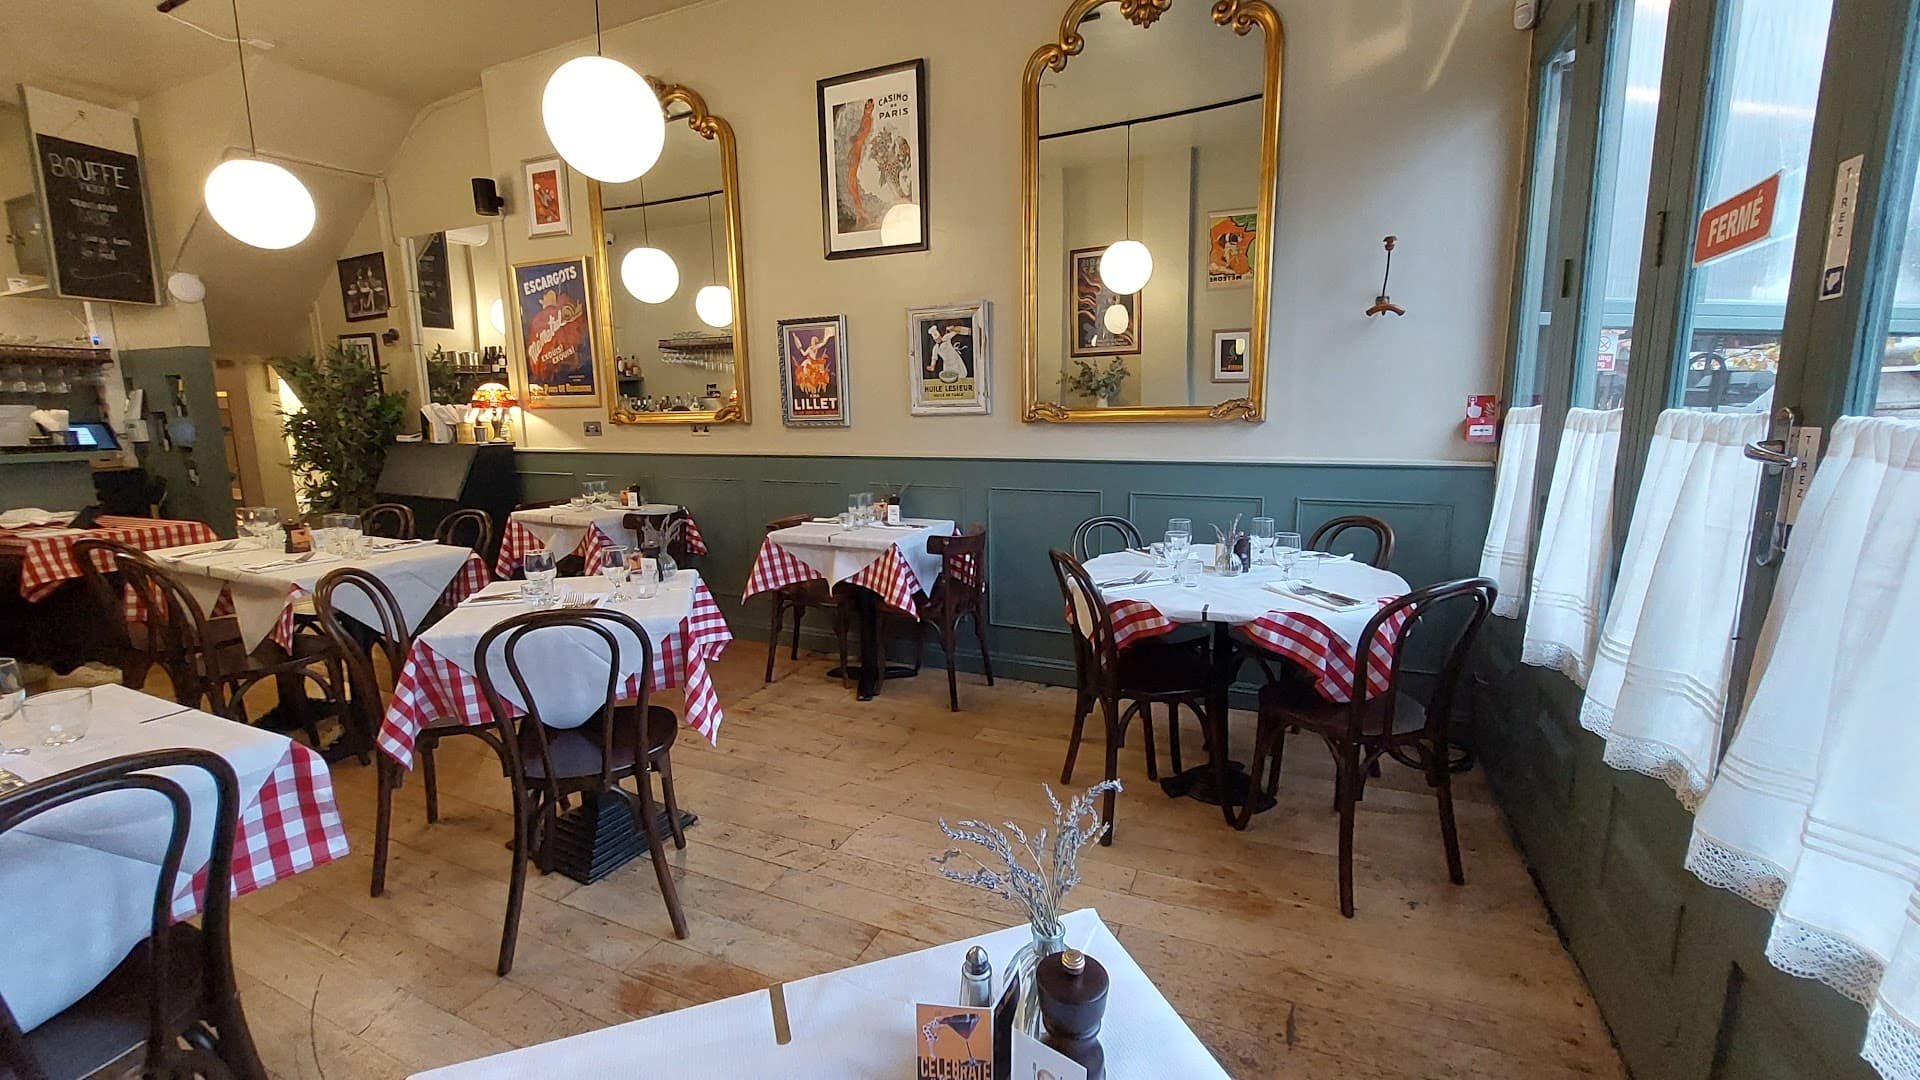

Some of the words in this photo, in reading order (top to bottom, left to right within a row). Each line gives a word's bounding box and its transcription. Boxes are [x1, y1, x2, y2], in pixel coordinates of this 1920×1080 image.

[879, 93, 908, 107] CASINO
[879, 107, 909, 120] PARIS
[48, 152, 131, 190] BOUFFE
[1836, 166, 1852, 238] TIREZ
[1706, 188, 1764, 248] FERMÉ
[523, 265, 577, 296] ESCARGOTS
[945, 384, 973, 392] LESIEUR
[794, 397, 838, 410] LILLET
[1796, 434, 1813, 498] TIREZ
[920, 1055, 991, 1080] CELEBRATE
